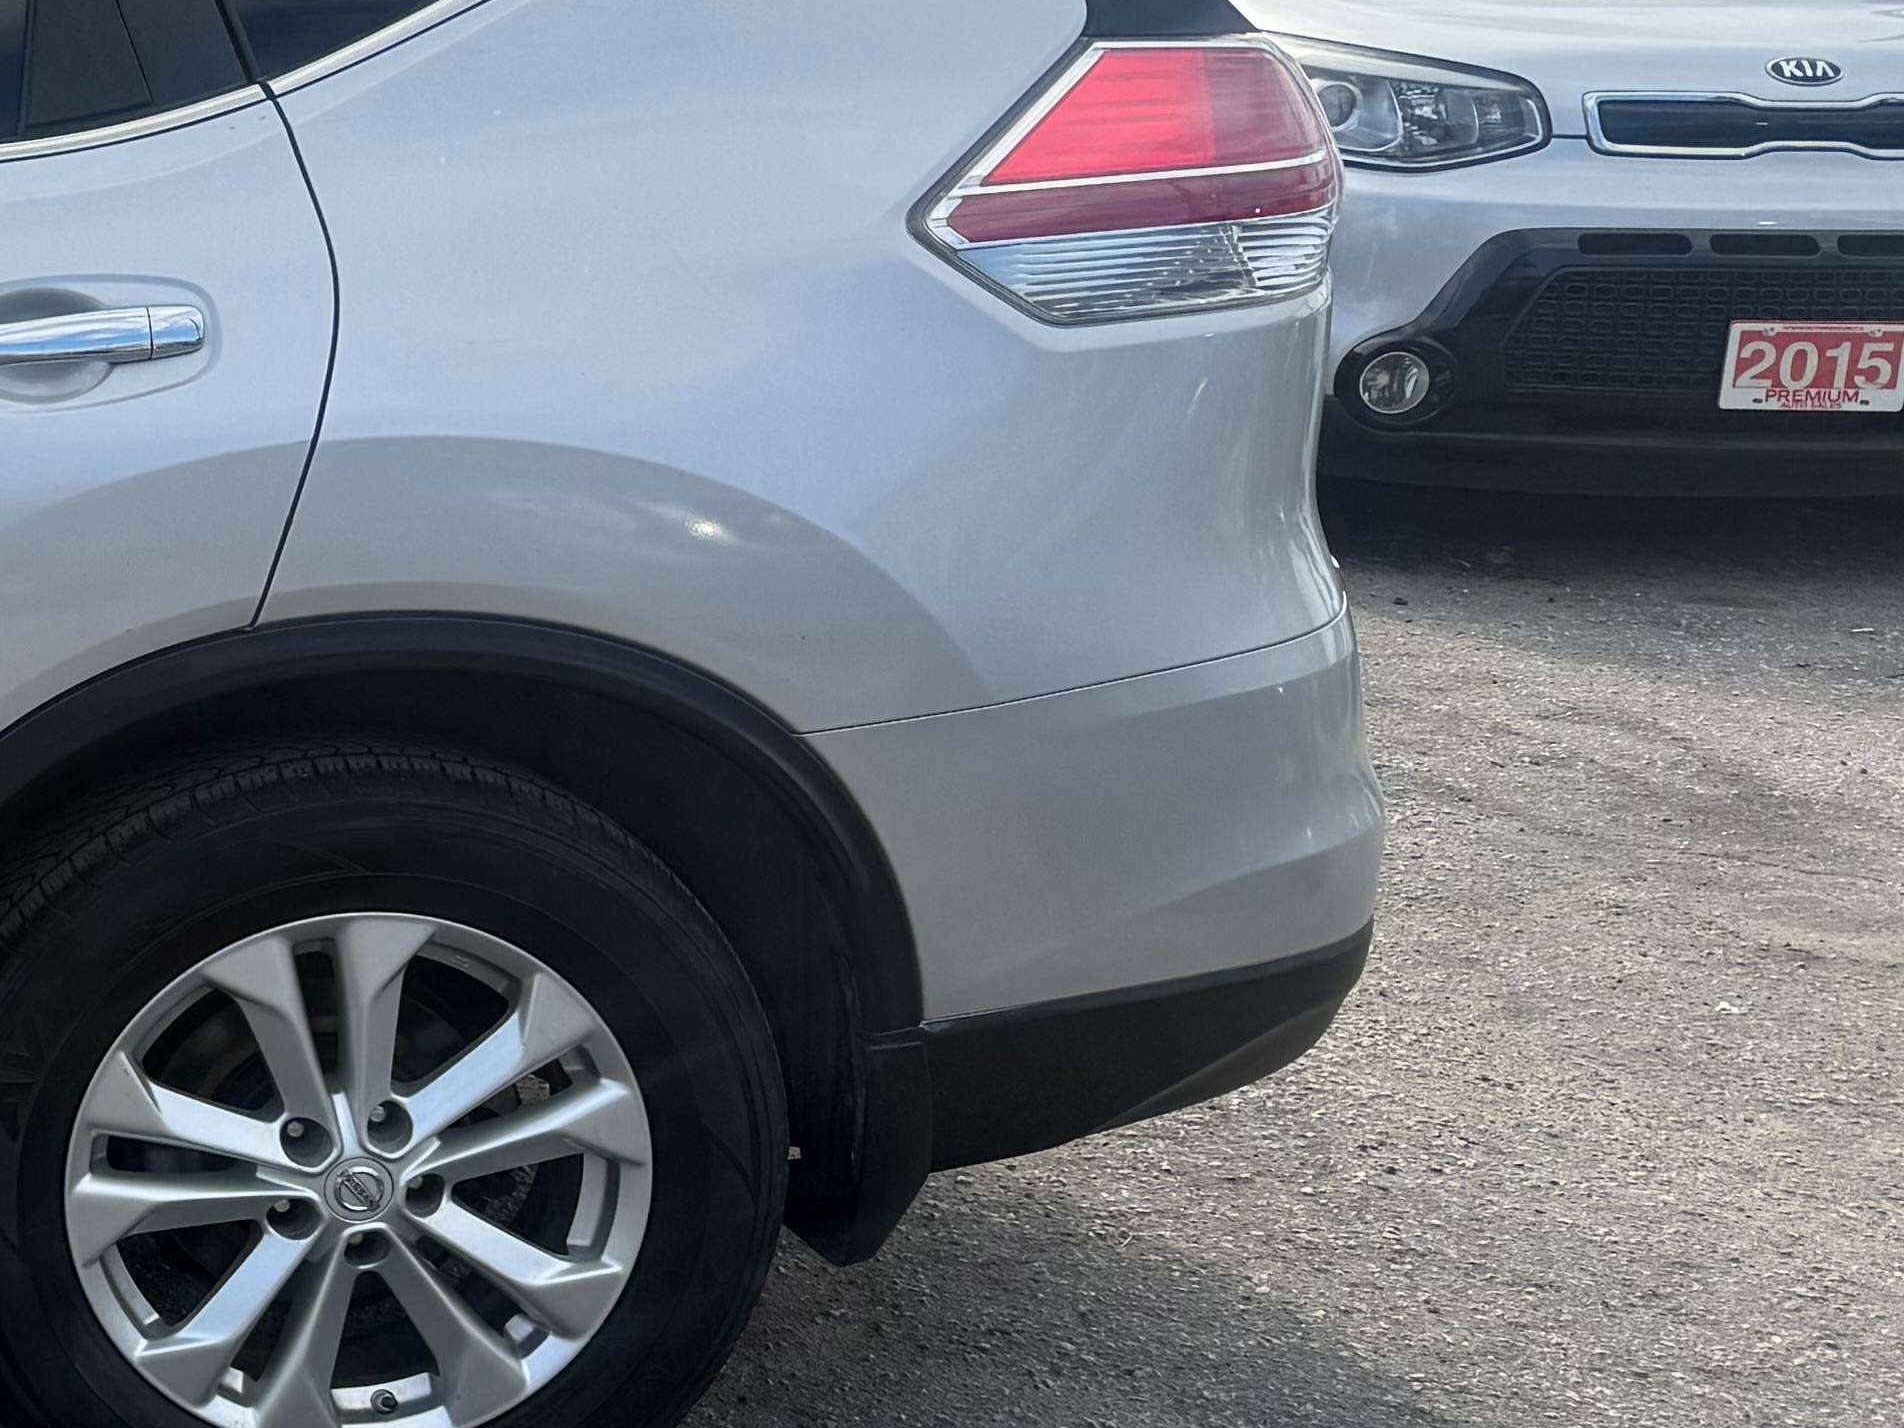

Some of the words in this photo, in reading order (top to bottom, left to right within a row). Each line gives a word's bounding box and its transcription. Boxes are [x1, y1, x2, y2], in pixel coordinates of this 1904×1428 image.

[1779, 59, 1835, 77] KIA
[1735, 340, 1895, 390] 2015
[1765, 389, 1860, 403] PREMIUM
